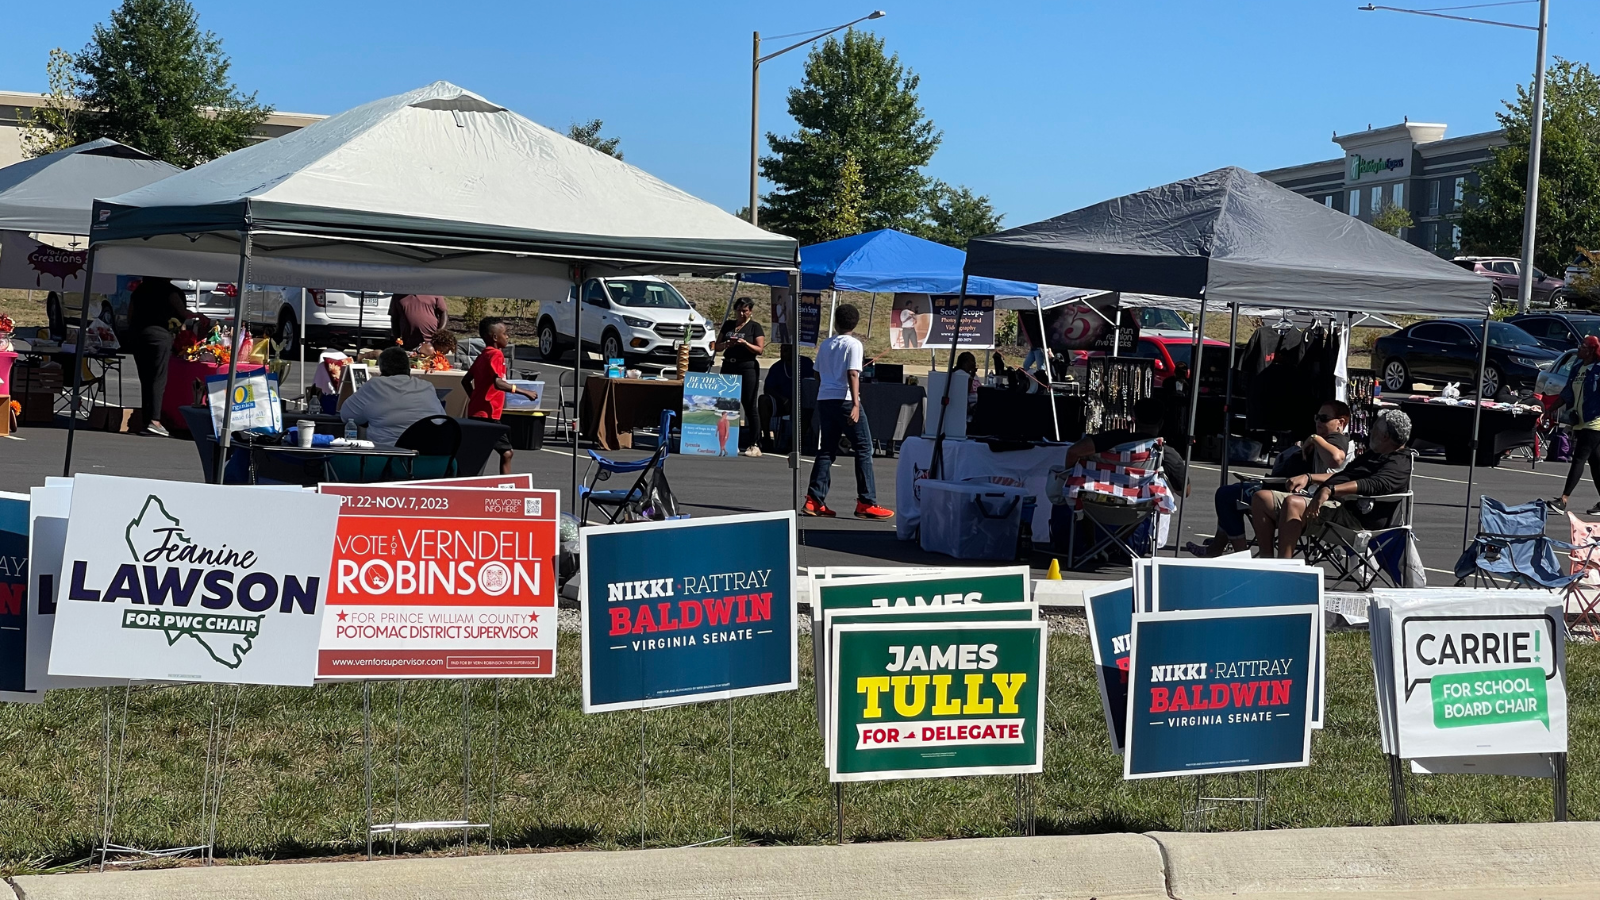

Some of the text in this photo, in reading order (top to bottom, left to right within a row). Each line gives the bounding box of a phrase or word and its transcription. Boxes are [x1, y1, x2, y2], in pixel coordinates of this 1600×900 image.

[31, 253, 83, 264] Creations
[962, 308, 984, 317] Scope
[686, 382, 718, 390] CHANGE
[420, 497, 449, 510] 2023
[485, 498, 521, 506] PWC VOTER
[485, 505, 501, 513] INFO
[144, 527, 258, 570] Jeanine
[337, 534, 388, 555] VOTE
[397, 528, 542, 561] VERNDELL
[68, 560, 321, 615] LAWSON
[337, 558, 541, 596] ROBINSON
[607, 569, 772, 602] NIKKI RATTRAY
[125, 612, 257, 632] FOR PWC CHAIR
[351, 612, 529, 624] FOR PRINCE WILLIAM COUNTY
[608, 592, 773, 637] BALDWIN
[336, 625, 539, 640] POTOMAC DISTRICT SUPERVISOR
[632, 629, 753, 651] VIRGINIA SENATE
[885, 643, 998, 672] JAMES
[1416, 629, 1541, 666] CARRIE!
[332, 657, 444, 667] www.vernforsupervisor.com
[1150, 663, 1208, 683] NIKKI
[1214, 658, 1293, 680] RATTRAY
[856, 673, 1027, 719] TULLY
[1149, 679, 1293, 714] BALDWIN
[1442, 678, 1535, 699] FOR SCHOOL
[1444, 697, 1537, 719] BOARD CHAIR
[1168, 711, 1272, 728] VIRGINIA SENATE
[862, 724, 1020, 745] FOR DELEGATE
